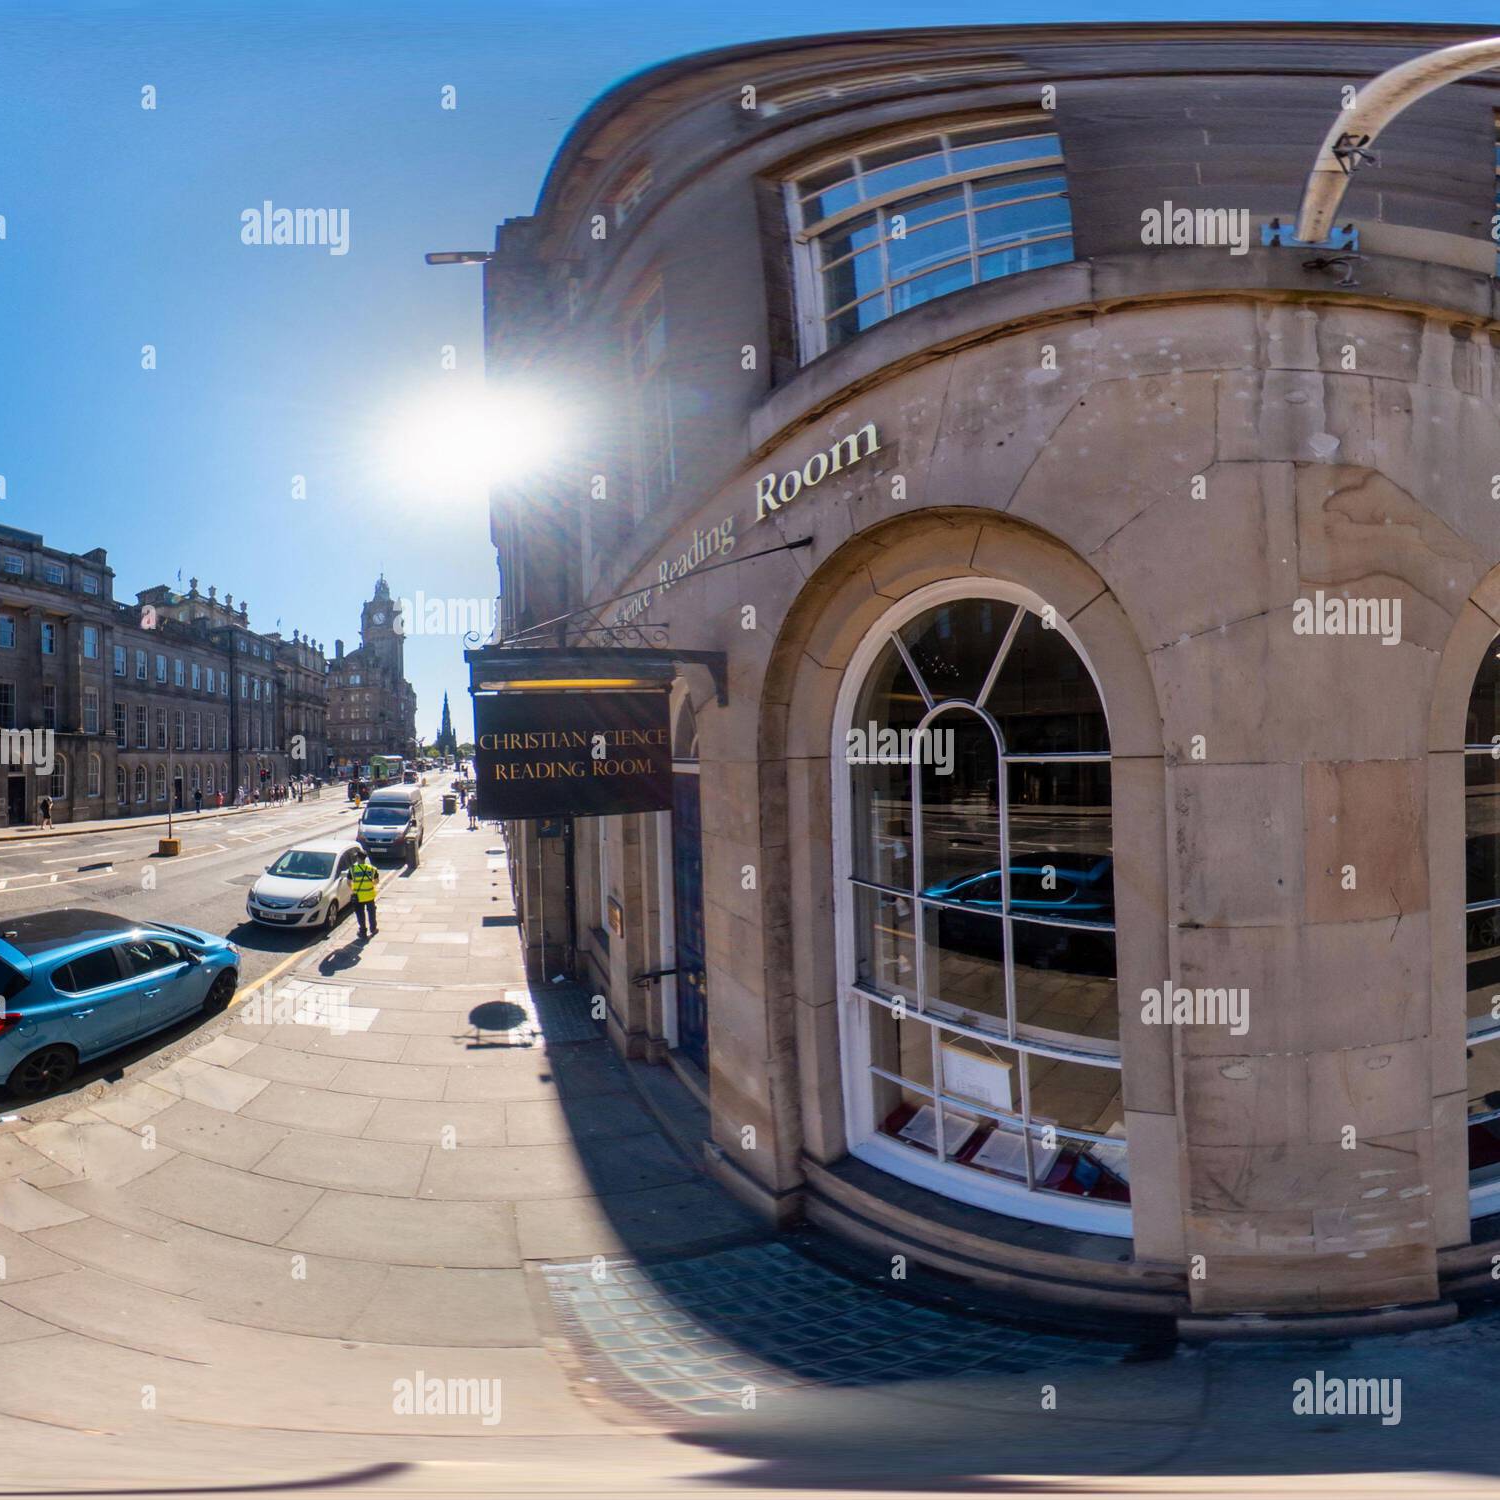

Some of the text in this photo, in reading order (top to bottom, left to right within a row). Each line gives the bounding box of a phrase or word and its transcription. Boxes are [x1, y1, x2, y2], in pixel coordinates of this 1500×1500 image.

[657, 514, 736, 594] Reading
[755, 420, 882, 523] Room
[479, 731, 586, 751] CHRISTIAN
[495, 761, 585, 781] READING
